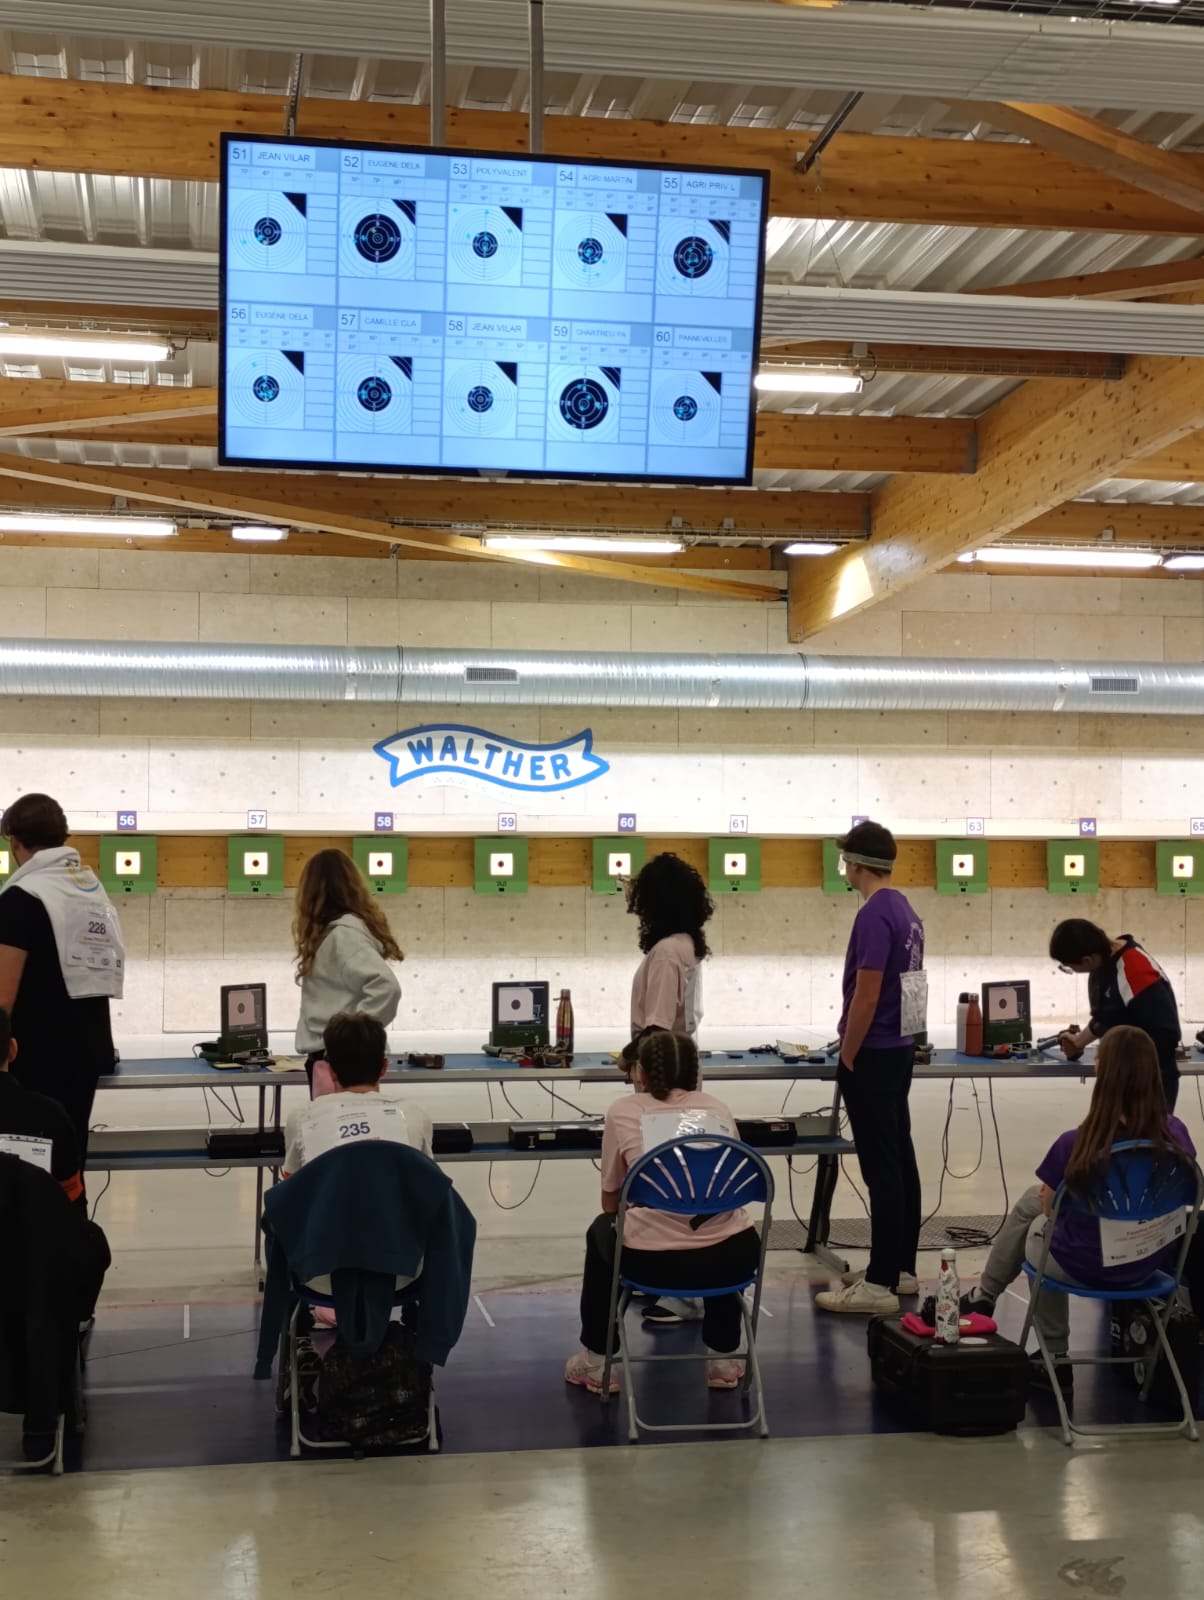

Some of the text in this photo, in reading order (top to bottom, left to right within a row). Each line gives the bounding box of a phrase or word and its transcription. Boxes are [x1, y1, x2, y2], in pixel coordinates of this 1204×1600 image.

[231, 149, 247, 160] 51
[257, 151, 311, 163] JEAN VILAR
[343, 156, 359, 167] 52
[367, 160, 399, 169] EUGENE
[453, 163, 468, 175] 53
[475, 166, 528, 178] POLYVALENT
[559, 171, 574, 182] 54
[603, 175, 634, 185] MARTIN
[663, 177, 678, 189] 55
[686, 180, 705, 189] AGRI
[231, 308, 247, 320] 56
[341, 314, 356, 326] 57
[448, 320, 463, 332] 58
[471, 322, 522, 334] JEAN VILAR
[553, 325, 568, 337] 59
[656, 331, 671, 343] 60
[406, 735, 572, 781] WALTHER
[119, 814, 135, 826] 56
[250, 813, 265, 825] 57
[376, 815, 392, 828] 58
[500, 817, 514, 828] 59
[620, 817, 634, 828] 60
[732, 818, 746, 829] 61
[968, 821, 983, 832] 63
[1081, 821, 1095, 832] 64
[1192, 821, 1204, 832] 65
[88, 921, 107, 935] 228
[339, 1121, 371, 1139] 235
